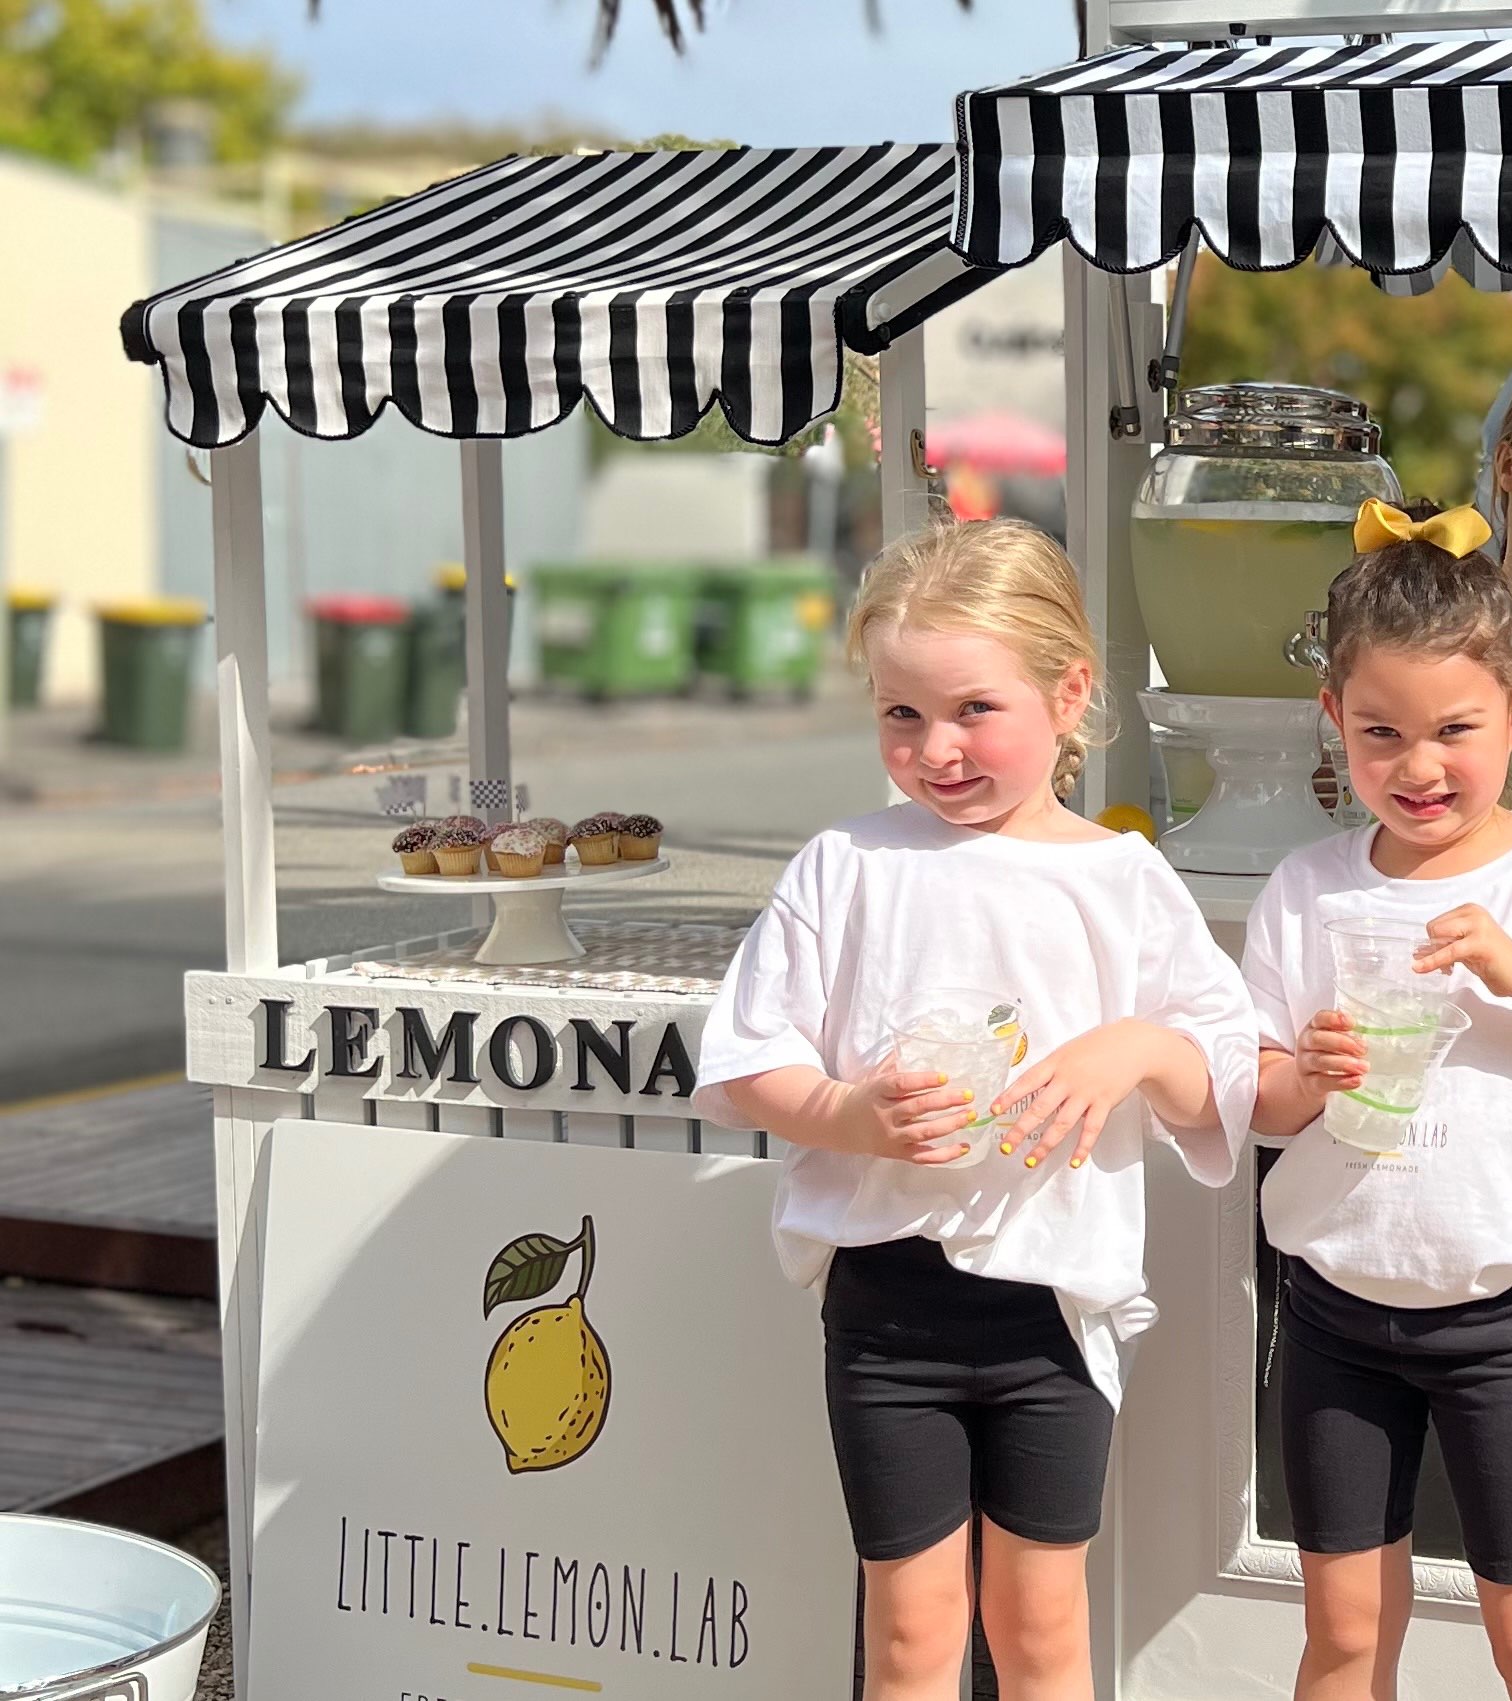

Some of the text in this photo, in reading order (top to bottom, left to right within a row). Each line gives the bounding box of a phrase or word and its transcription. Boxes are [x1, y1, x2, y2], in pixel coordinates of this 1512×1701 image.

[258, 998, 698, 1098] LEMONA
[1371, 1161, 1419, 1173] LEMONADE
[337, 1517, 748, 1668] LITTLE.LEMON.LAB
